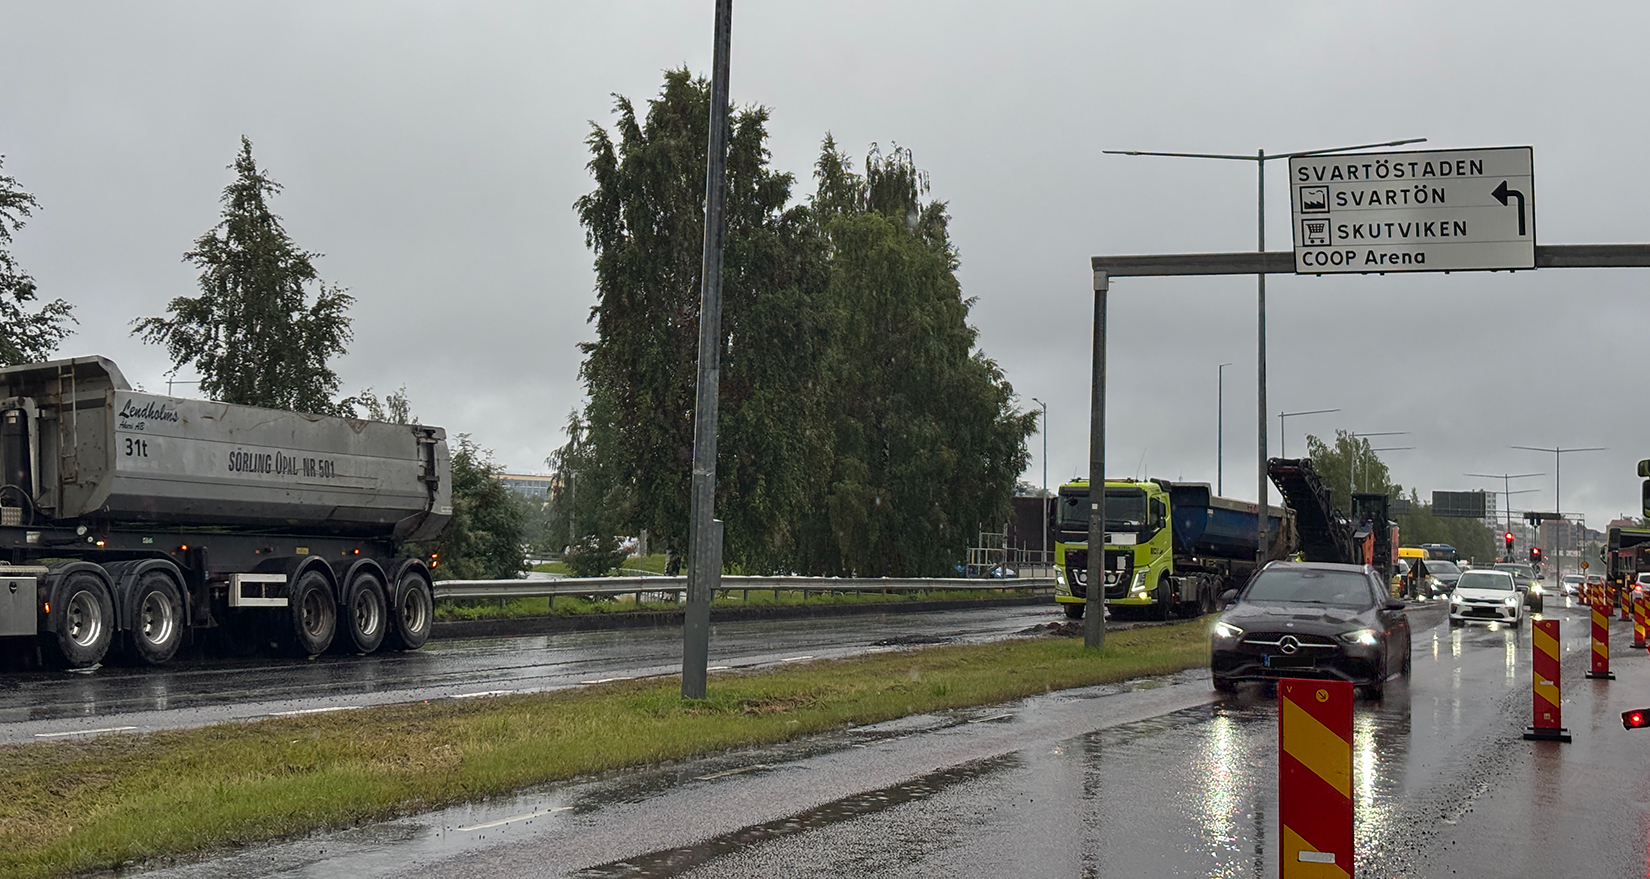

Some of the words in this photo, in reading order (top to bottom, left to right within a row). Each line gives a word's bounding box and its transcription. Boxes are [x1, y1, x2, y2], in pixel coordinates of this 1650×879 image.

[1297, 159, 1483, 182] SVARTÖSTADEN
[1335, 184, 1446, 207] SVARTÖN
[1337, 220, 1467, 240] SKUTVIKEN
[1302, 250, 1357, 266] COOP
[1364, 249, 1426, 265] Arena
[118, 399, 179, 423] Lendholms
[134, 421, 145, 431] AB
[125, 438, 148, 457] 31t
[228, 447, 272, 474] SÖRLING
[303, 457, 317, 477] NR
[319, 459, 335, 479] 501
